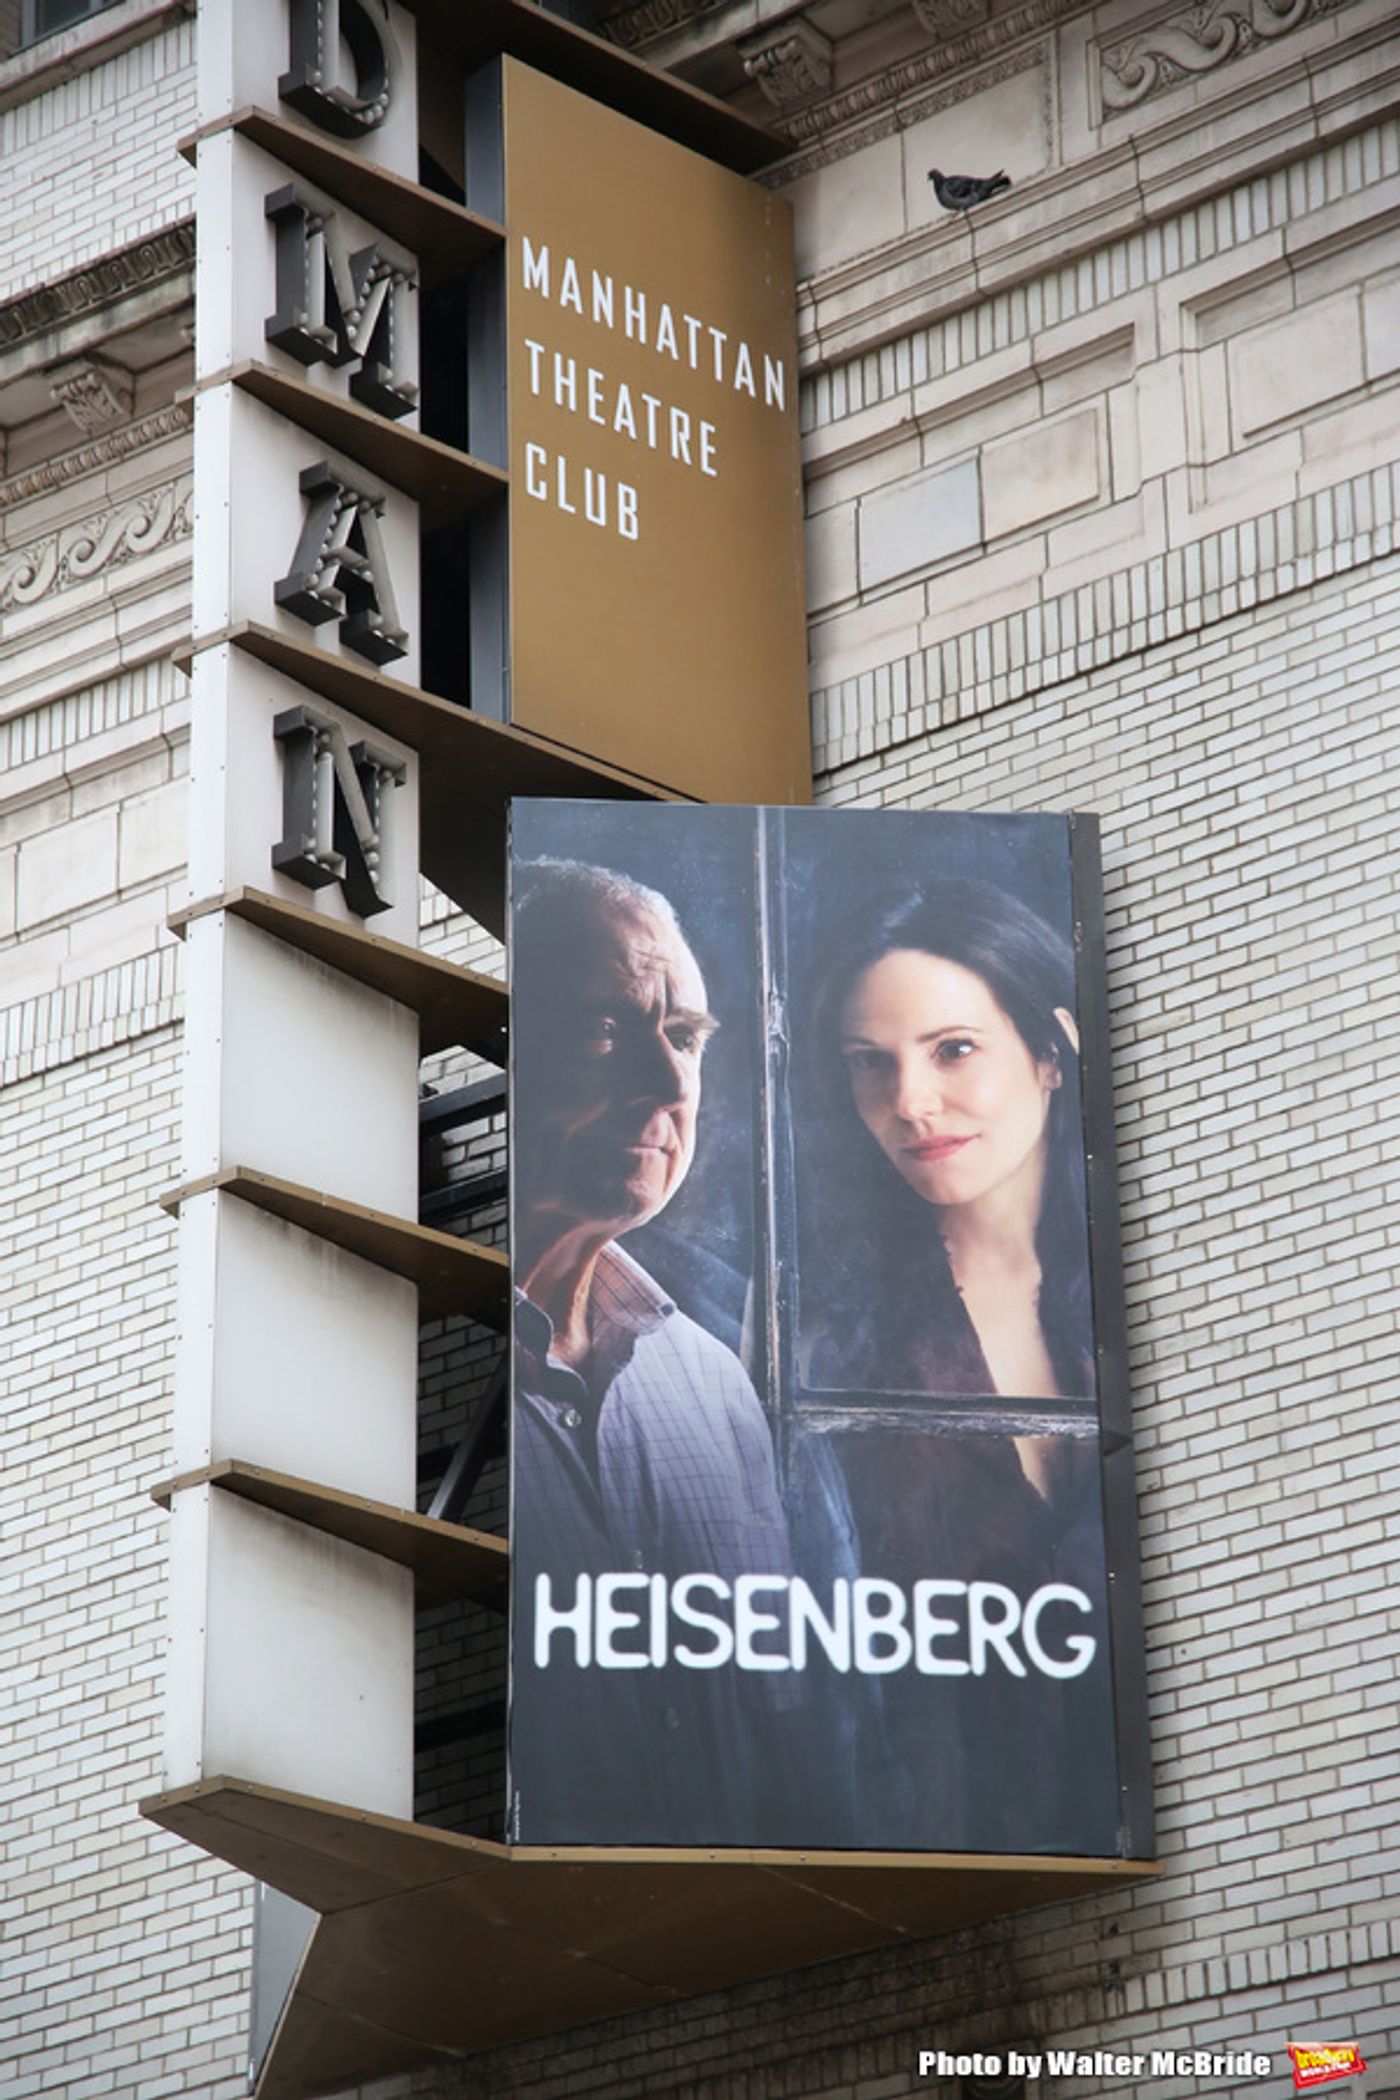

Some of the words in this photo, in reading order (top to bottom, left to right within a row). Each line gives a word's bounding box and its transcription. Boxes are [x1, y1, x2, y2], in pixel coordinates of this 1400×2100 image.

[522, 236, 786, 412] MANHATTAN
[524, 338, 718, 477] THEATRE
[525, 442, 639, 541] CLUB
[534, 1573, 1096, 1680] HEISENBERG
